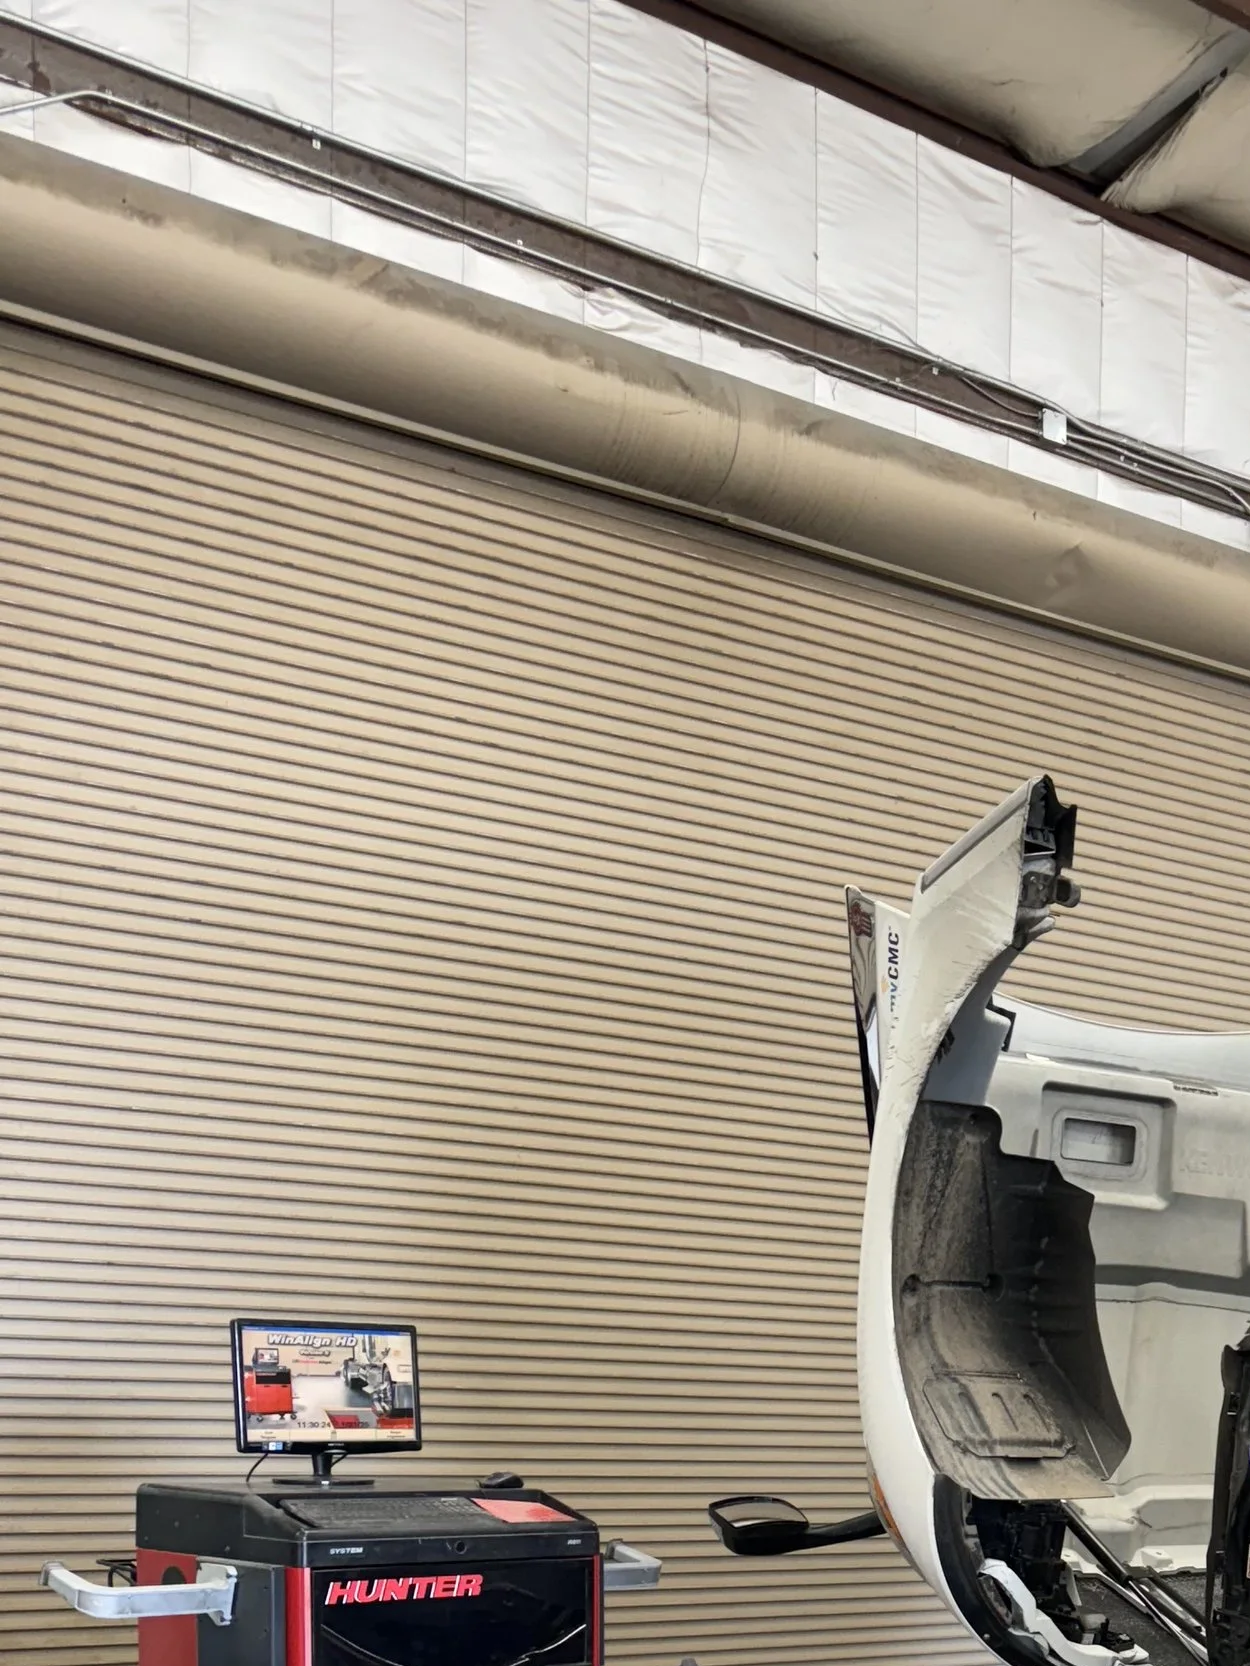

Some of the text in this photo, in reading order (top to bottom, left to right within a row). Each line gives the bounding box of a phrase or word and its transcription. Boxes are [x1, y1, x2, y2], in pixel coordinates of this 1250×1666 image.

[268, 1334, 357, 1347] WinAlign HD
[329, 1547, 363, 1555] SYSTEM
[324, 1574, 484, 1606] HUNTER
